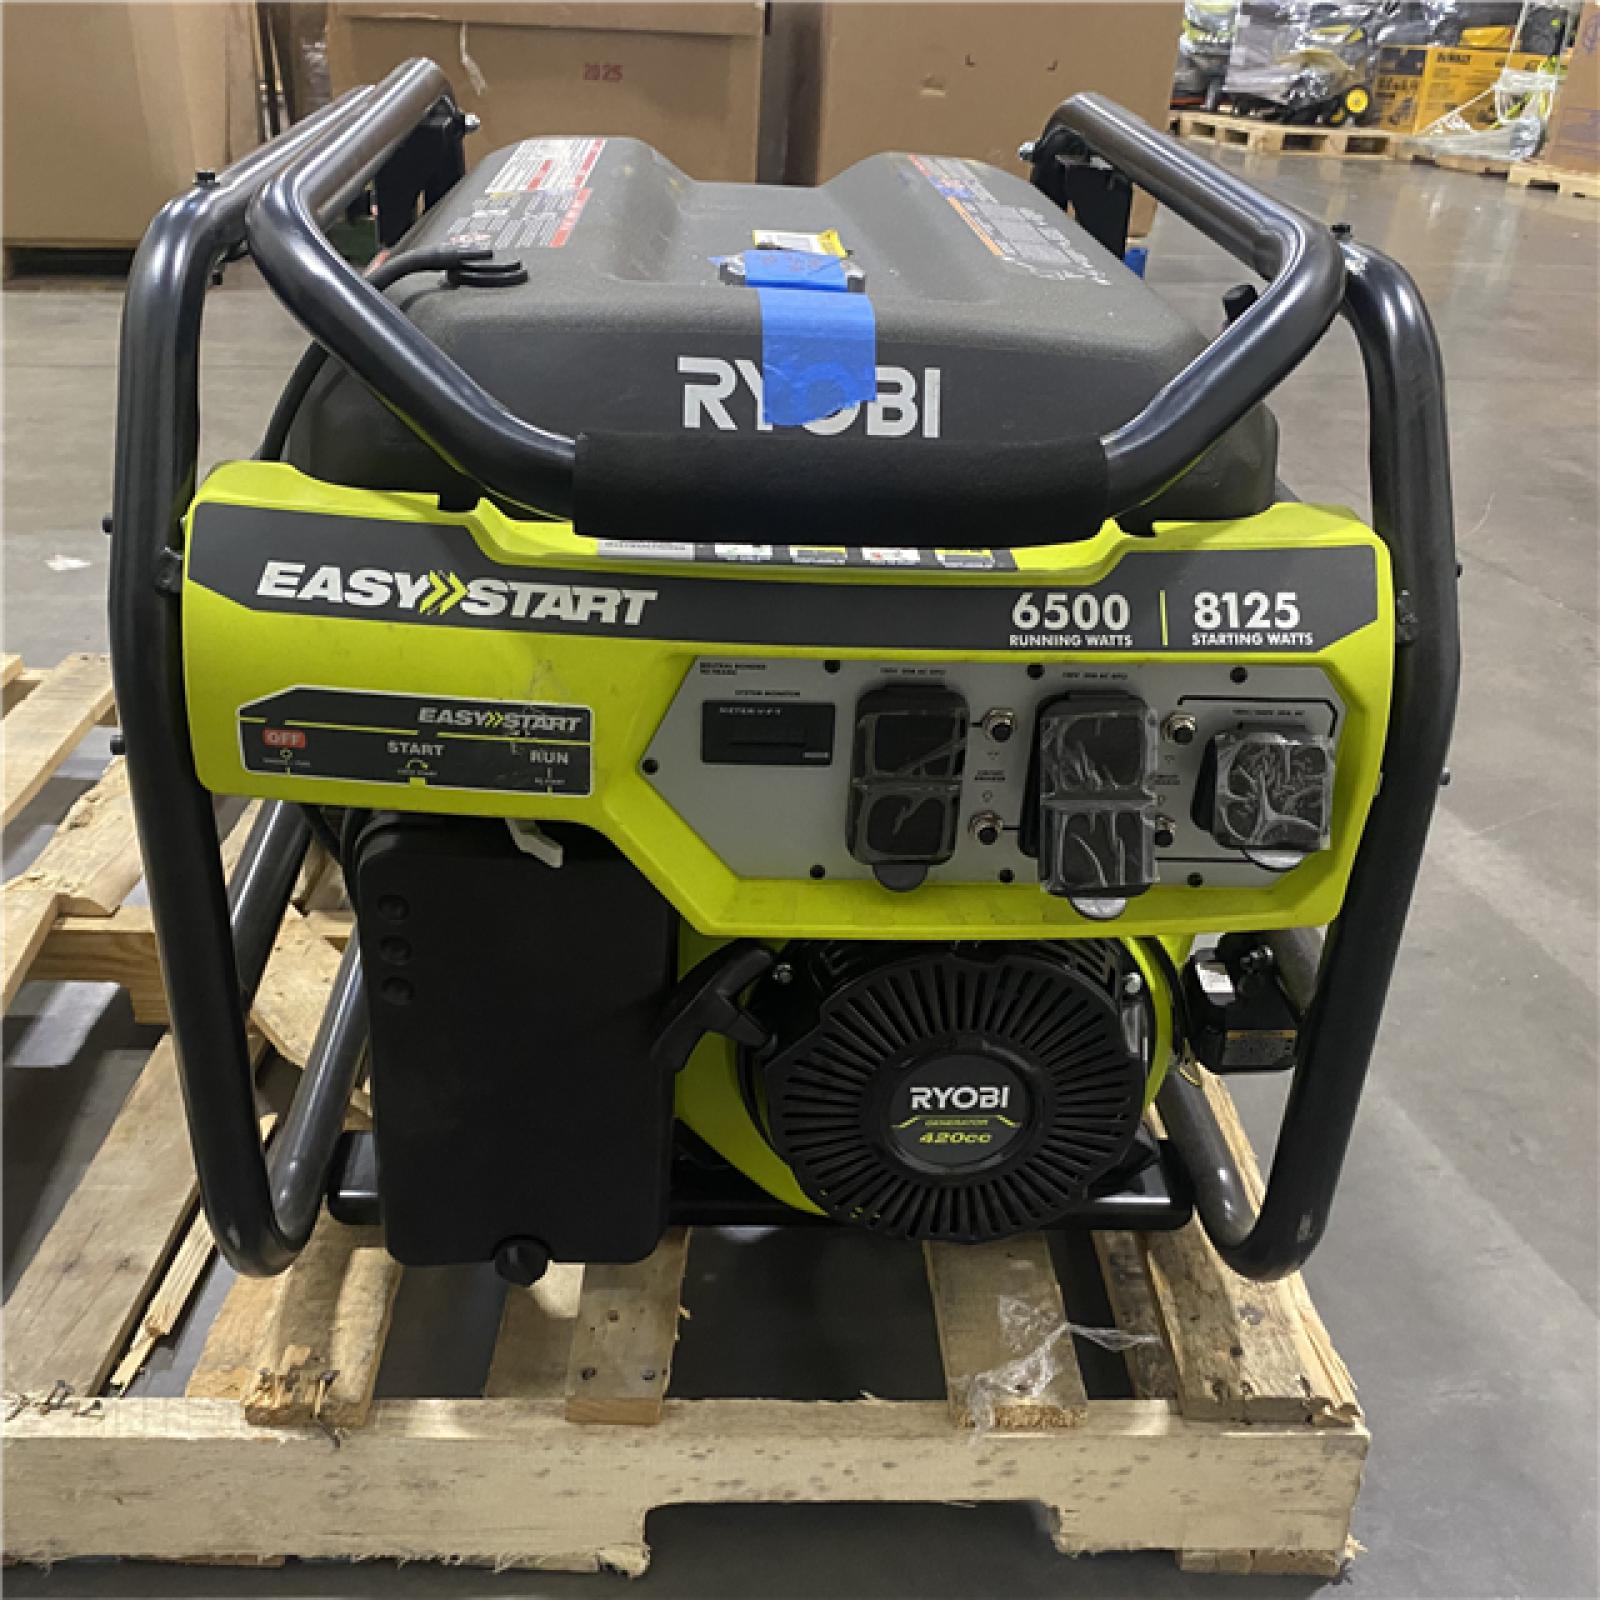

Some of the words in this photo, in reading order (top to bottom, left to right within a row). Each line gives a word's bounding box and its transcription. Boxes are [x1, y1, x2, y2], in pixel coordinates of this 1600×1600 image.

[677, 355, 941, 438] RYBI
[256, 559, 432, 609] EASY
[461, 578, 658, 625] START
[1011, 591, 1131, 631] 6500
[1194, 590, 1301, 630] 8125
[1009, 634, 1081, 647] RUNNING
[1084, 634, 1133, 648] WATTS
[1191, 632, 1264, 646] STARTING
[1267, 632, 1314, 647] WATTS
[417, 707, 488, 726] EASY
[501, 712, 582, 732] START
[386, 740, 444, 756] START
[529, 750, 569, 765] RUN
[909, 1085, 1011, 1110] RYOBI
[919, 1132, 992, 1144] 420cc
